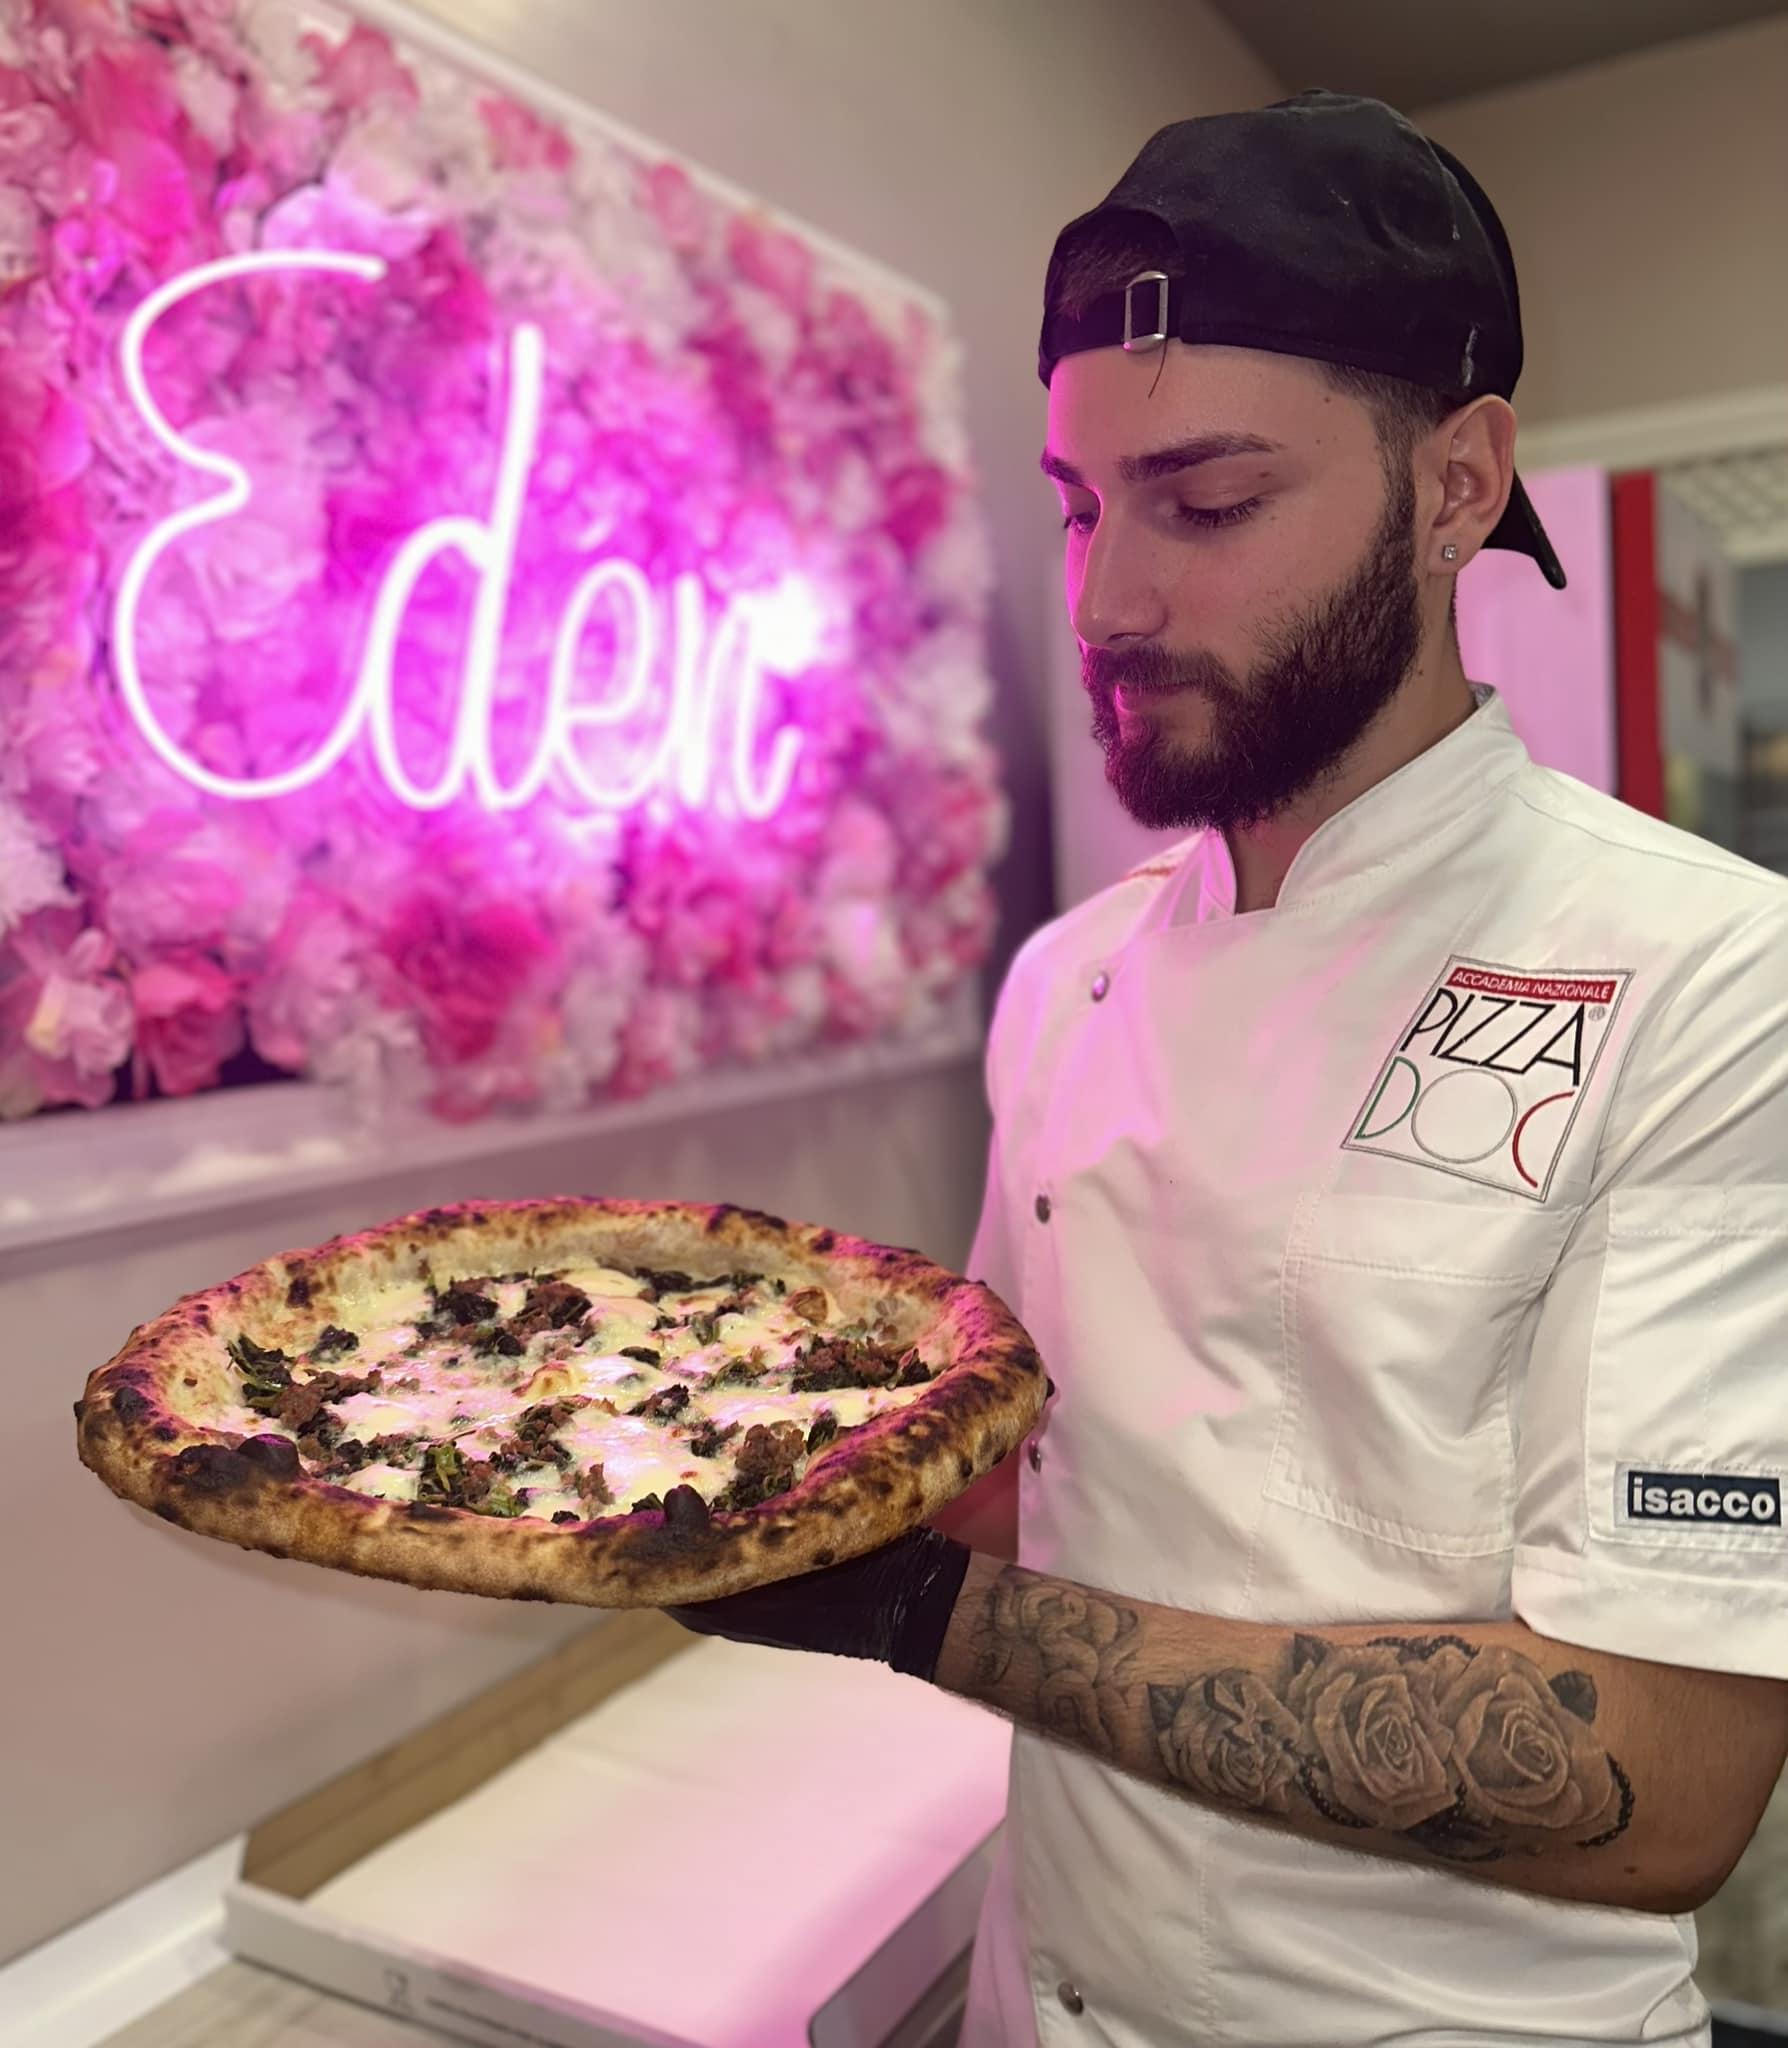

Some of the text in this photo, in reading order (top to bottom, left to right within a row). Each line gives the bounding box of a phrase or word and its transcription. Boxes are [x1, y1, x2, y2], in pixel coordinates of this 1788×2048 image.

[114, 249, 802, 819] Eden
[1451, 970, 1611, 1000] ACCADEMIA NAZIONALE
[1399, 987, 1586, 1087] PIZZA
[1354, 1056, 1576, 1189] DOC
[1632, 1476, 1777, 1521] isacco
